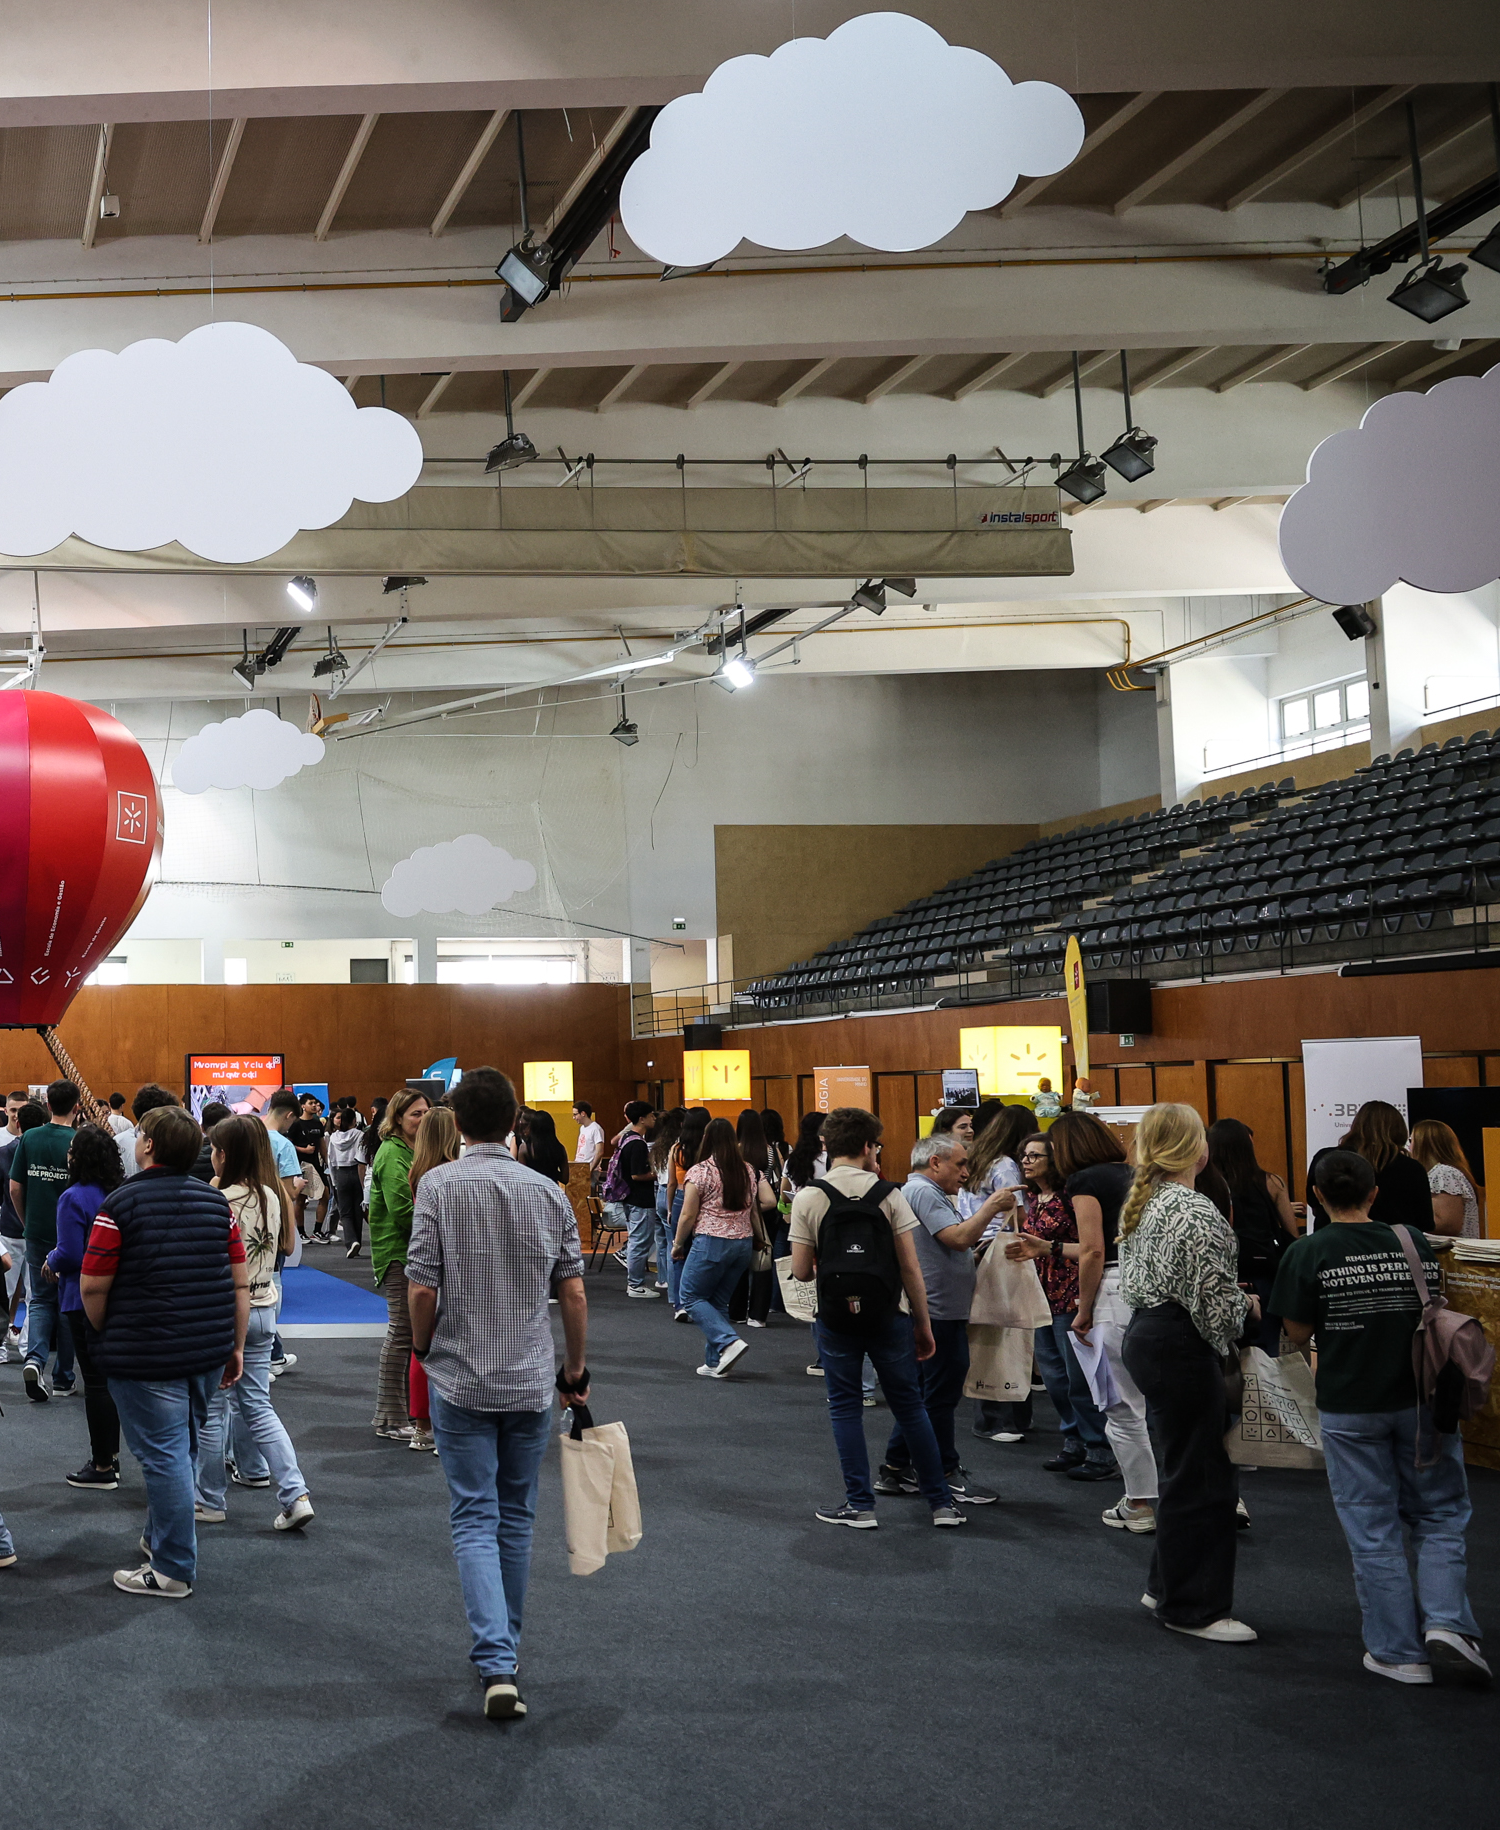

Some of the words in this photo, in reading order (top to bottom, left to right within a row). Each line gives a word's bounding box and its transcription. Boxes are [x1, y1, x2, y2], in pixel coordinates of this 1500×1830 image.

[990, 512, 1058, 524] instalsport
[40, 1171, 68, 1180] PROJECT
[1345, 1252, 1389, 1262] REMEMBER
[1366, 1264, 1378, 1272] IS
[1322, 1278, 1345, 1288] NOT
[1345, 1274, 1375, 1285] EVEN
[1375, 1272, 1392, 1281] OR
